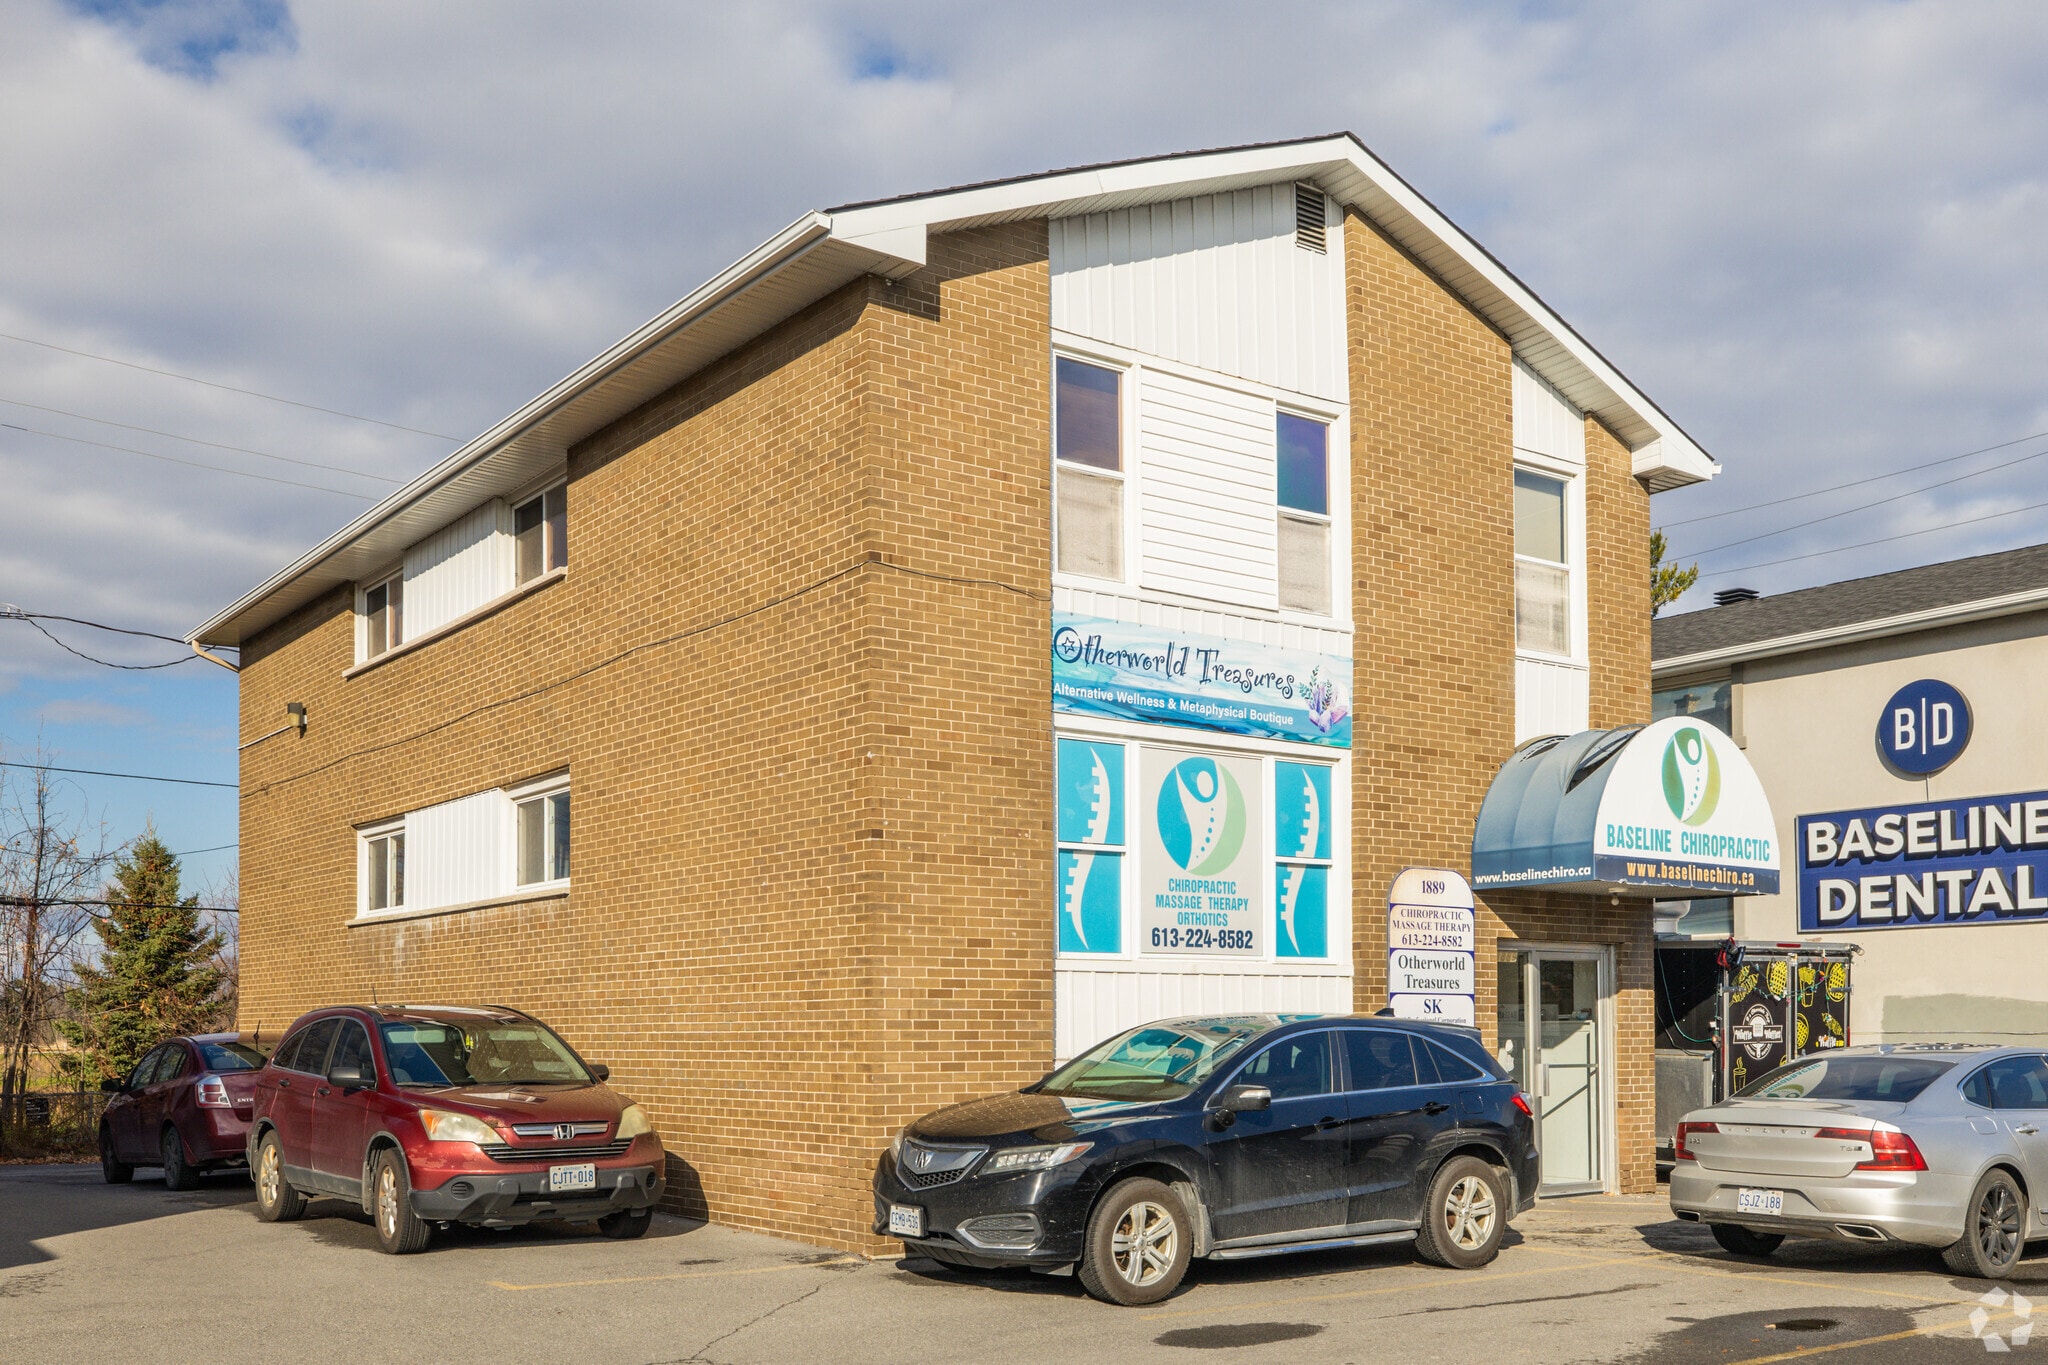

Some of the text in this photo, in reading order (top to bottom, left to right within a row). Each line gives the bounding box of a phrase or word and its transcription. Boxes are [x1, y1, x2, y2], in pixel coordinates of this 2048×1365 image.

[1054, 626, 1296, 700] Otherworld Treasures
[1054, 682, 1294, 727] Alternative Wellness & Metaphysical Boutique
[1808, 800, 2048, 862] BASELINE
[1606, 824, 1770, 862] BASELINE CHIROPRACTIC
[1475, 866, 1591, 884] www.baselinechiro.ca
[1626, 862, 1755, 887] www.baselinechiro.ca
[1168, 878, 1236, 896] CHIROPRACTIC
[1421, 880, 1445, 895] 1889
[1820, 865, 2048, 921] DENTAL
[1155, 894, 1249, 912] MASSAGE THERAPY
[1177, 912, 1228, 927] ORTHOTICS
[1400, 908, 1464, 921] CHIROPRACTIC
[1392, 920, 1472, 933] MASSAGE THERAPY
[1151, 927, 1254, 950] 613-224-8582
[1402, 934, 1463, 948] 613-224-8582
[1398, 954, 1465, 971] Otherworld
[1404, 974, 1460, 990] Treasures
[1424, 998, 1442, 1014] SK
[1728, 1127, 1808, 1136] VOLVO
